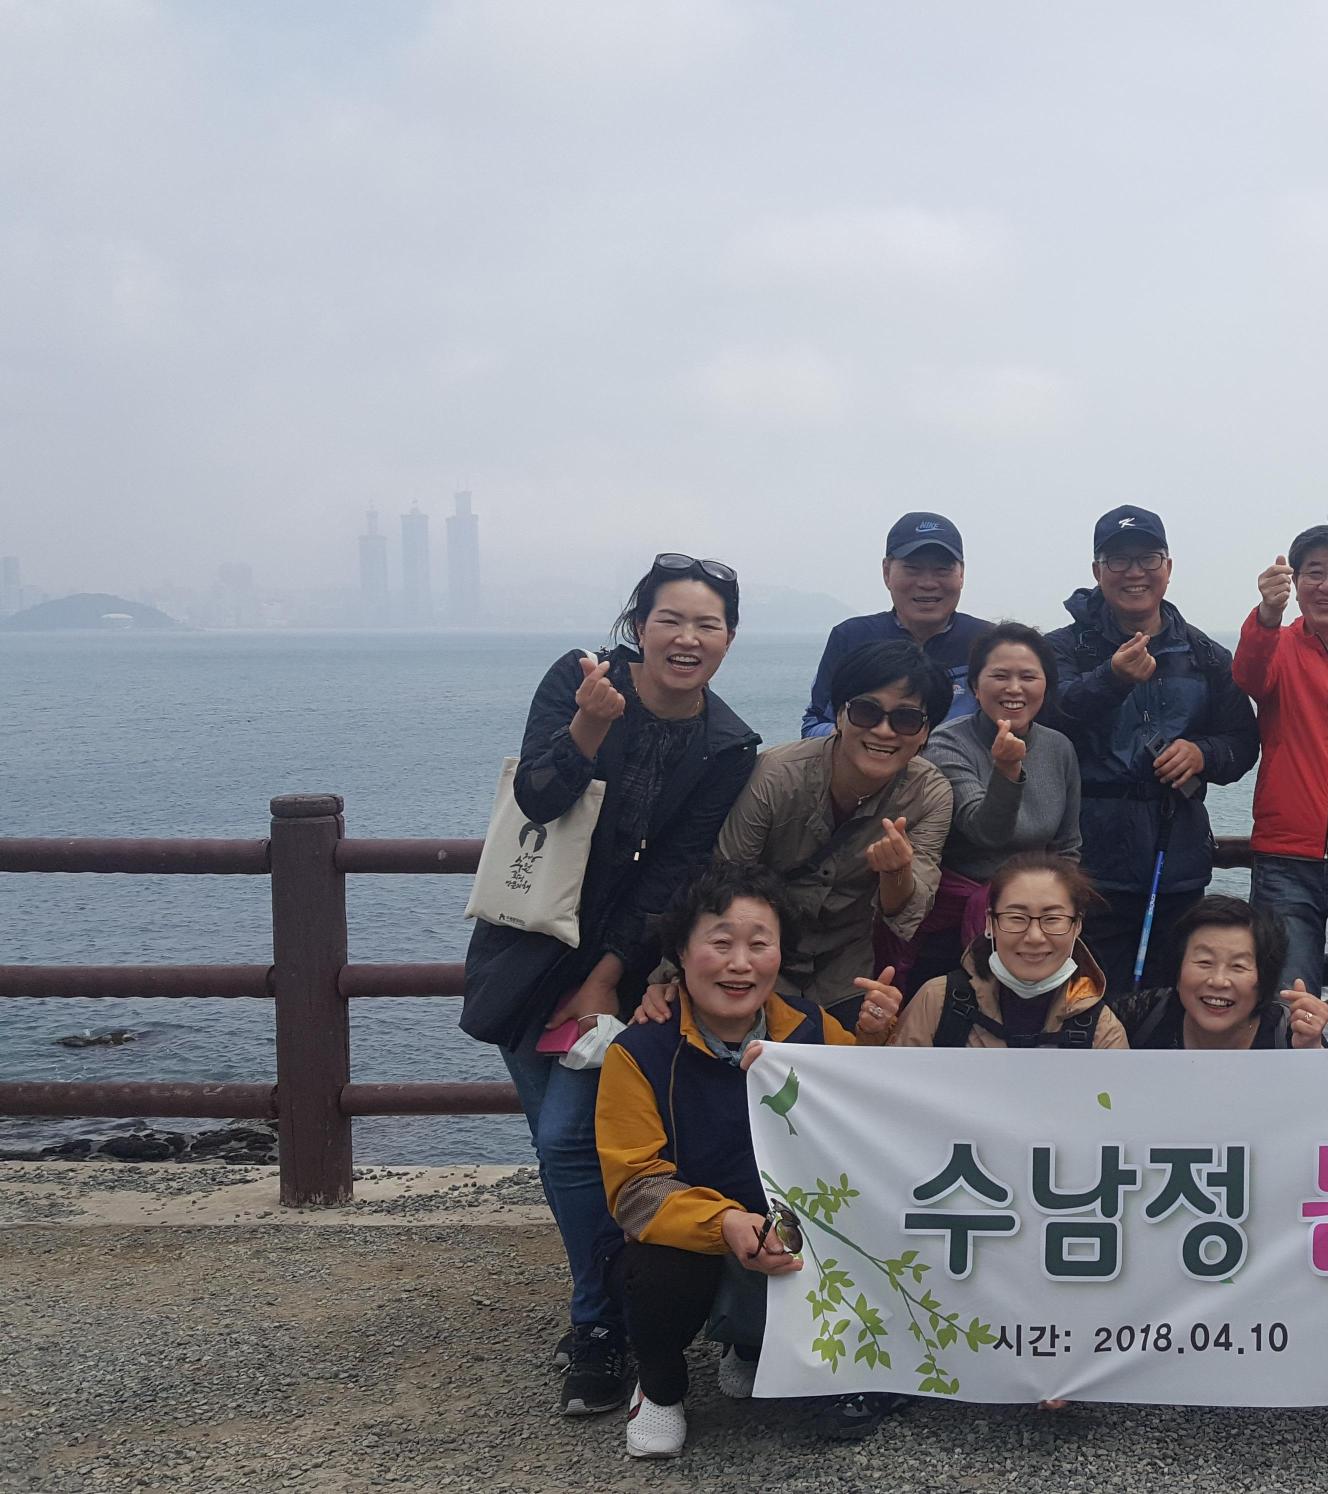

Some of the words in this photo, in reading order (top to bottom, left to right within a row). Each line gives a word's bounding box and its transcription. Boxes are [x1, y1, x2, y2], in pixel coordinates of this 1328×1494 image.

[920, 520, 940, 529] NIKE
[903, 1141, 1249, 1280] 수남정
[992, 1324, 1072, 1357] 시간:
[1093, 1322, 1289, 1356] 2018.04.10
